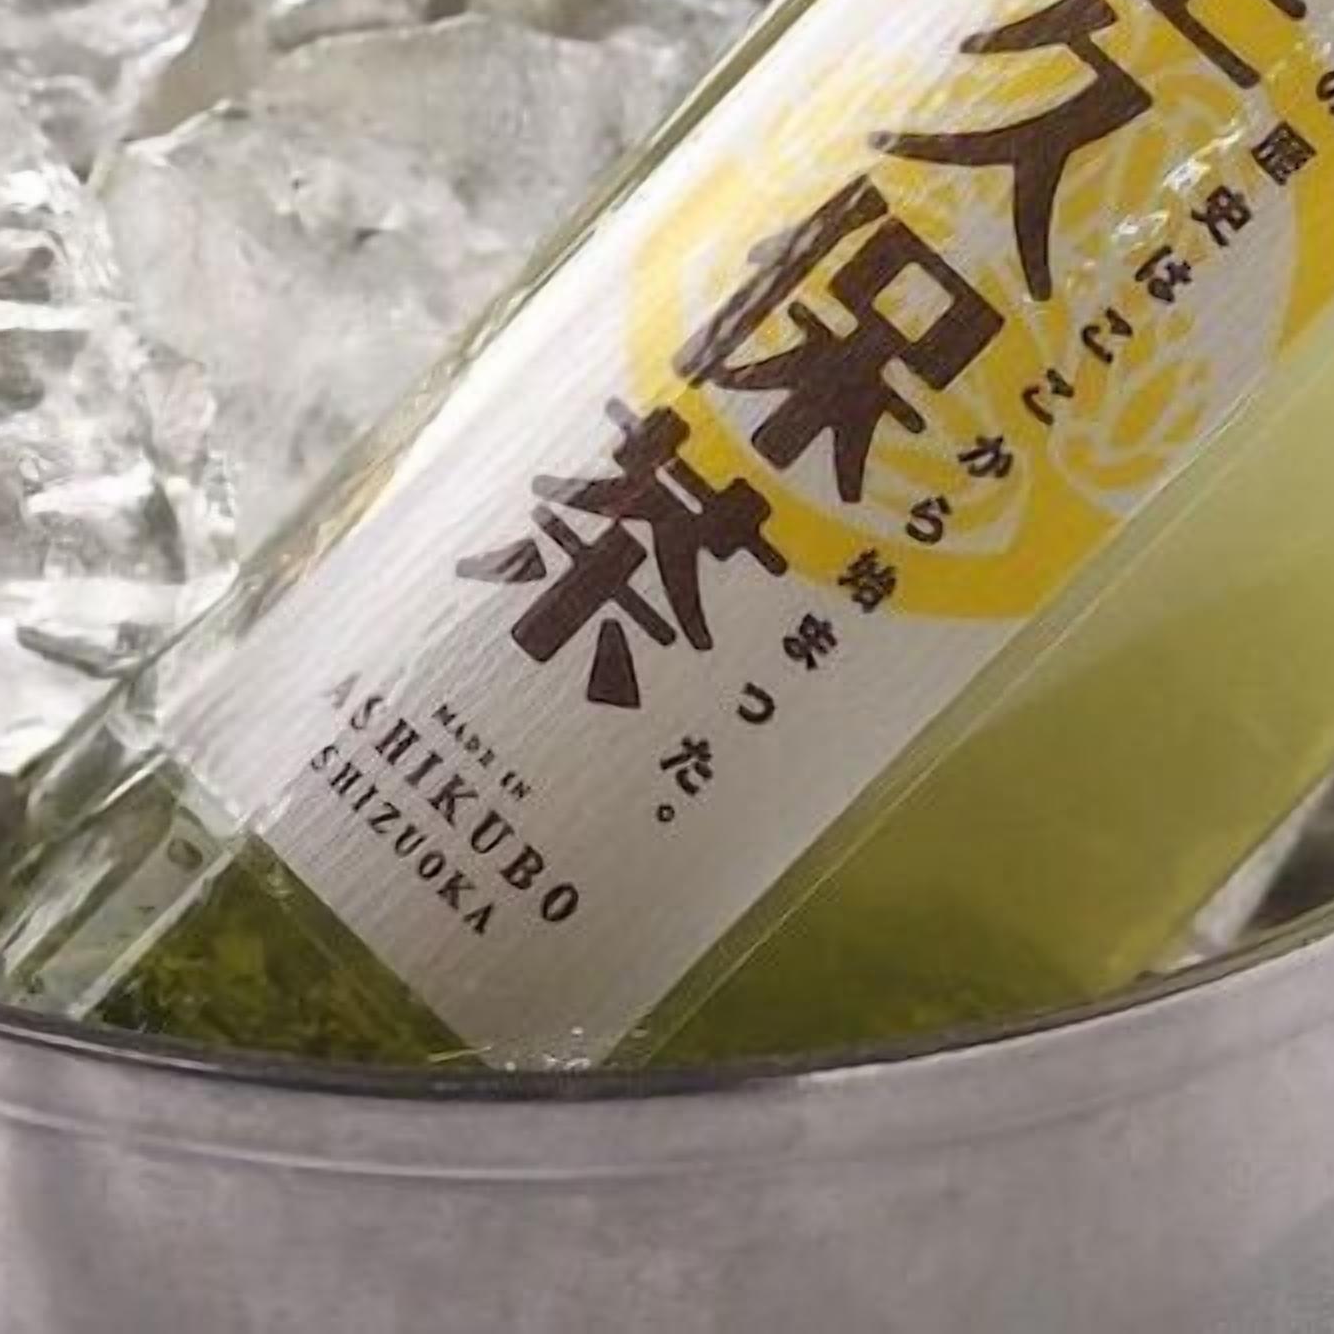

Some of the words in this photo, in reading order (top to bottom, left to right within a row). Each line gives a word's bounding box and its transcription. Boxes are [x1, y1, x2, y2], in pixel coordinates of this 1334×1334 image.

[310, 744, 495, 936] SHIZUOKA
[326, 671, 580, 923] ASHIKUBO
[431, 703, 496, 767] MADE
[499, 770, 533, 801] IN
